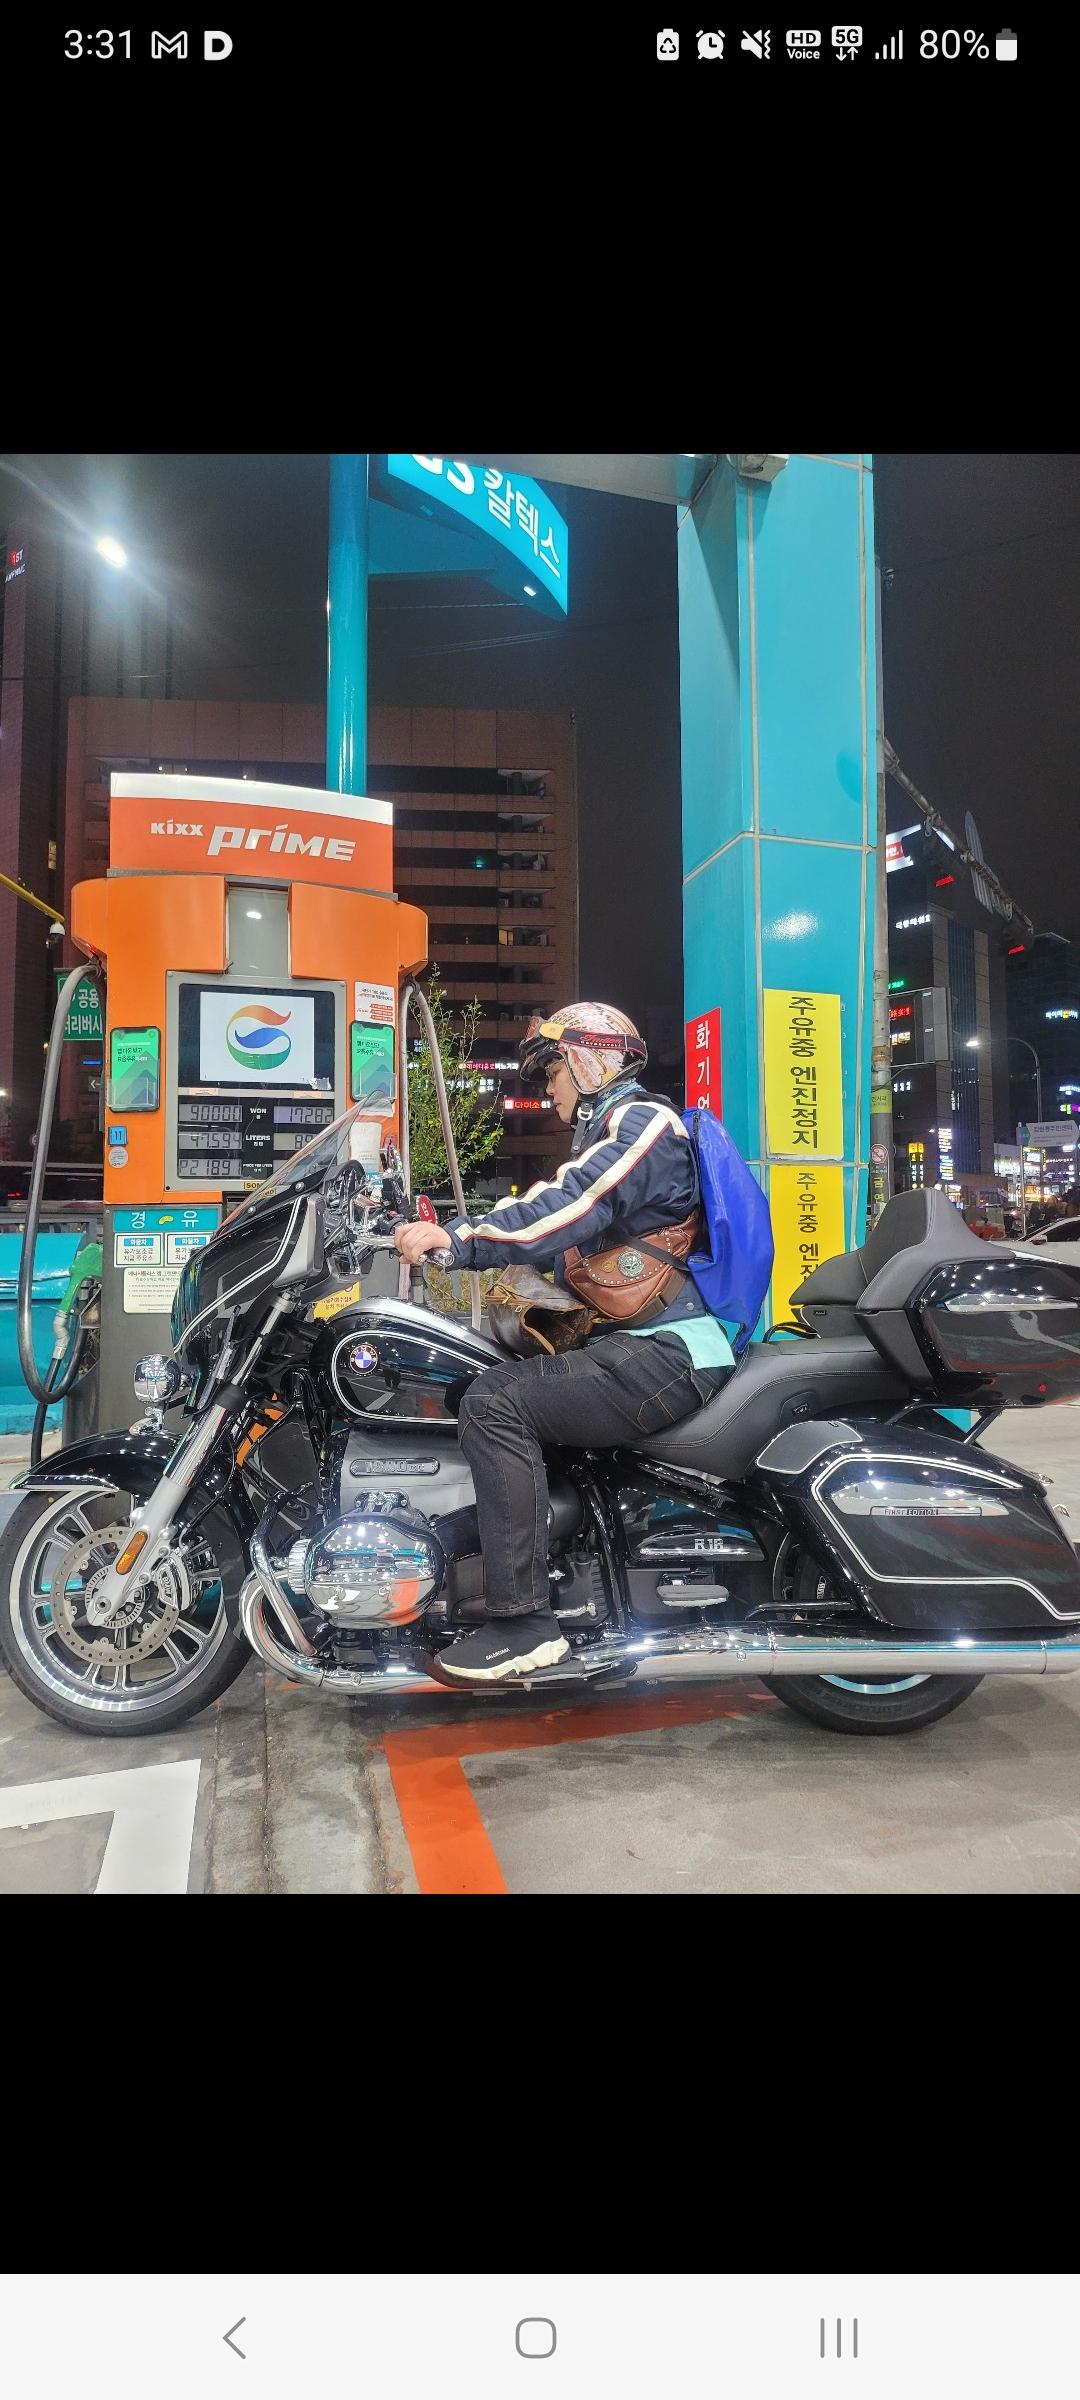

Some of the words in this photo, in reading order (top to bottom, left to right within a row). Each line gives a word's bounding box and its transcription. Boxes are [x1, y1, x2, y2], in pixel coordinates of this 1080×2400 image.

[484, 468, 561, 579] 칼텍스
[78, 988, 100, 1008] 공용
[788, 996, 817, 1058] 주유중
[190, 1105, 242, 1122] 90000
[514, 1101, 541, 1109] 다이소
[790, 1066, 818, 1149] 엔진정지
[289, 1107, 335, 1124] 17282
[796, 1172, 819, 1233] 주유중
[131, 1211, 146, 1229] 경
[181, 1210, 199, 1228] 유
